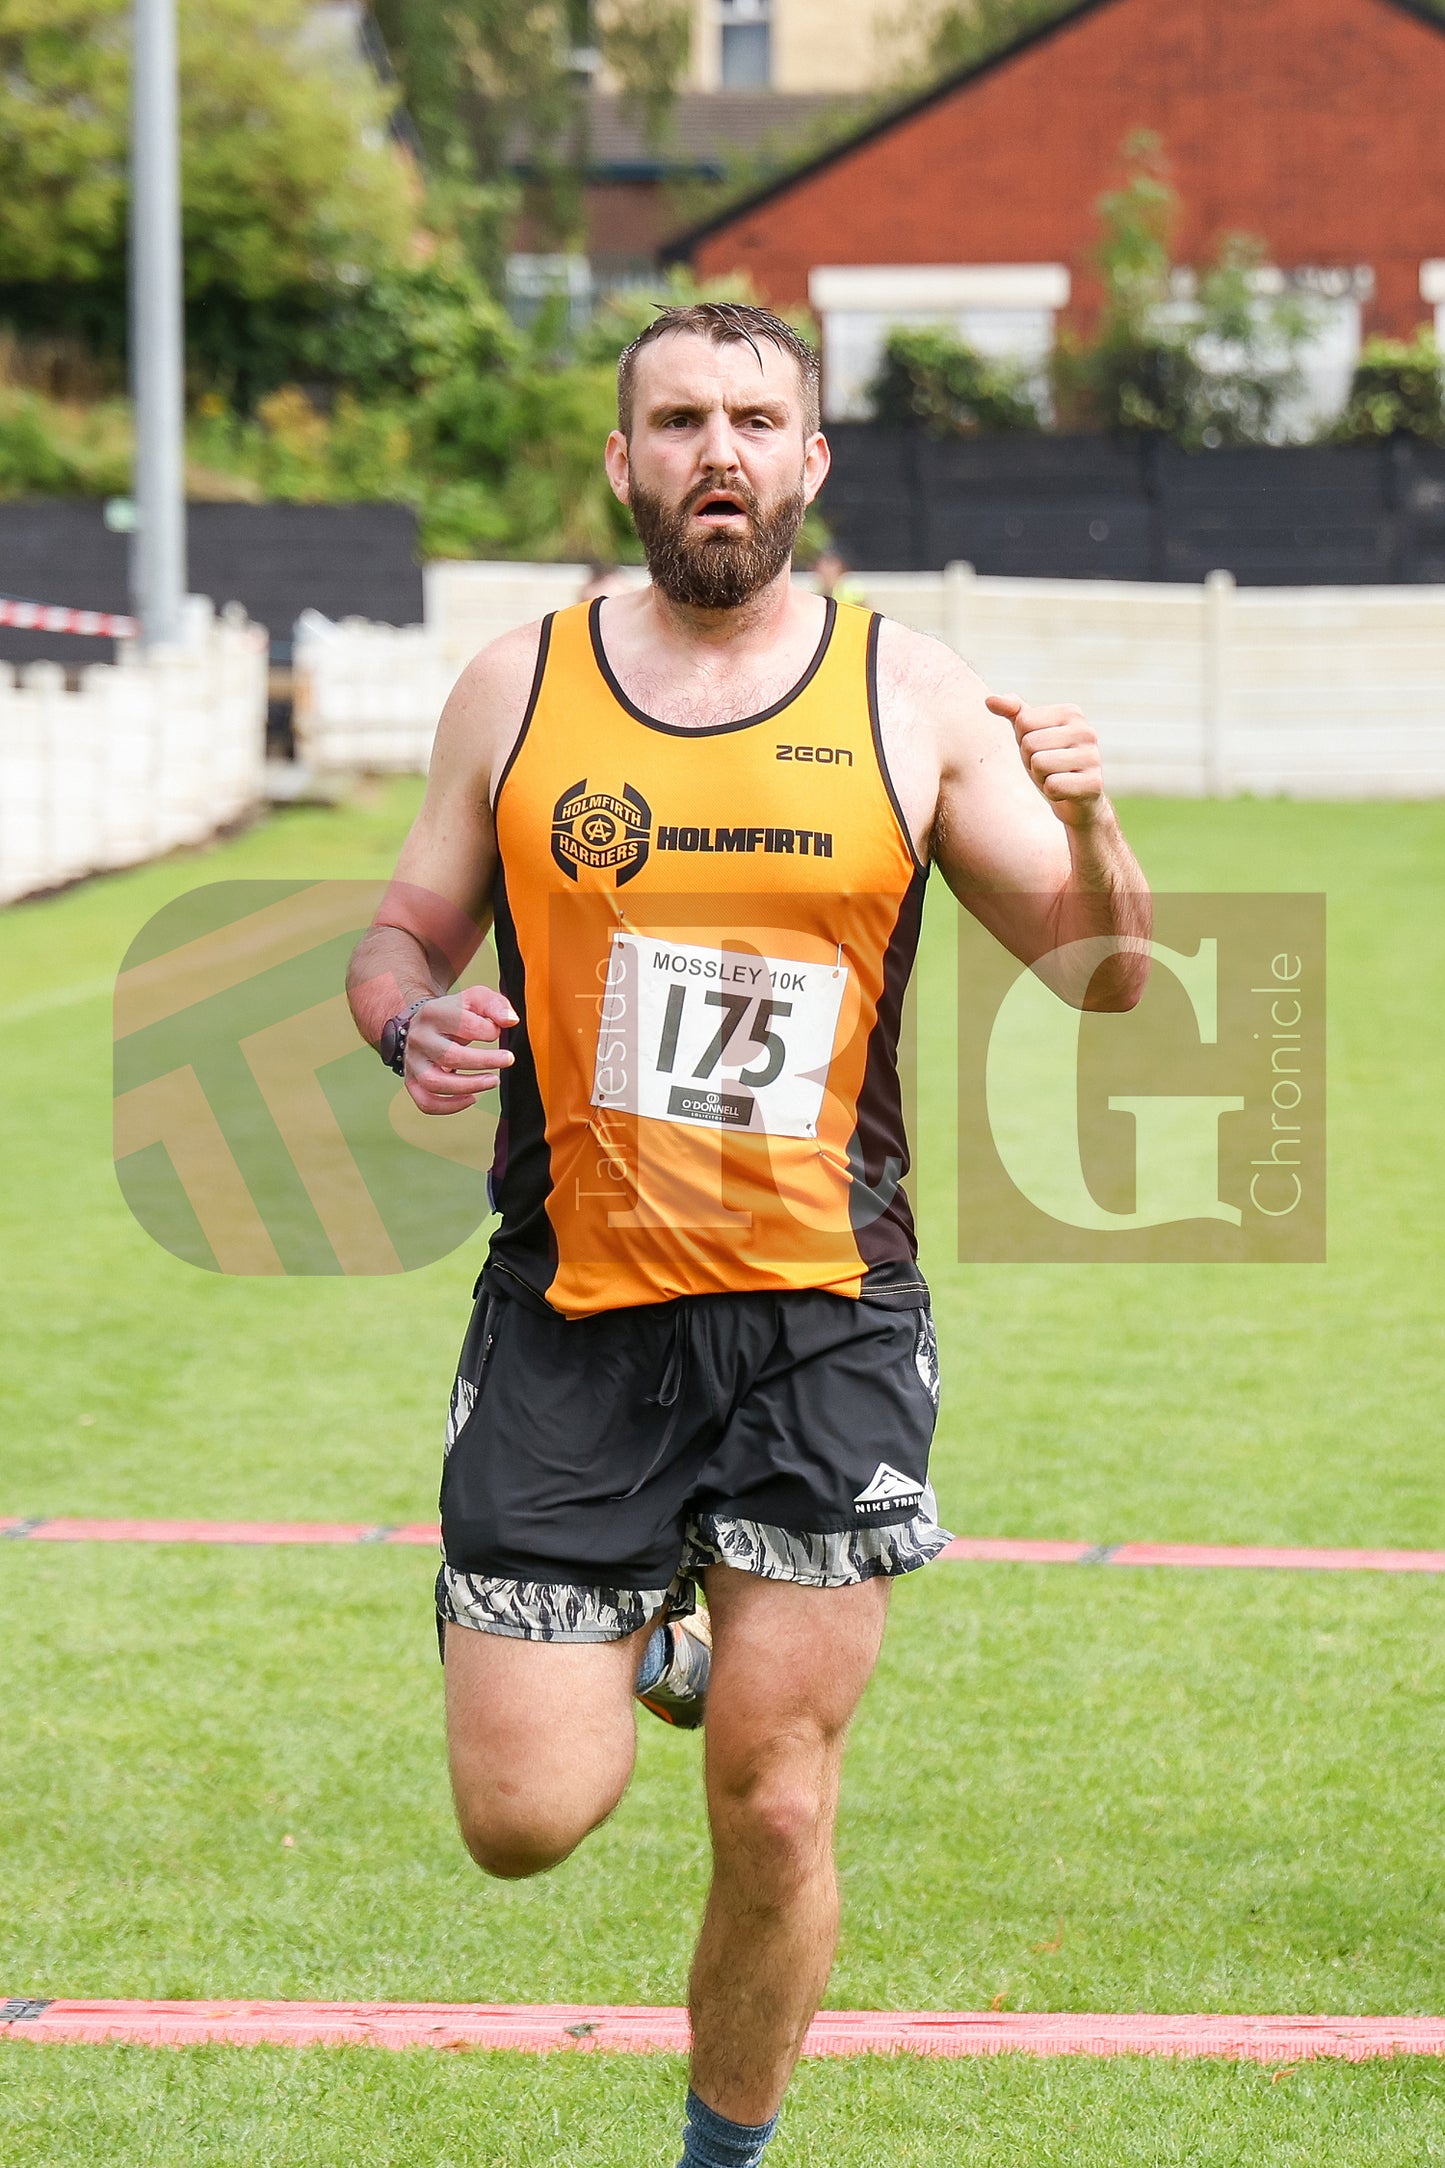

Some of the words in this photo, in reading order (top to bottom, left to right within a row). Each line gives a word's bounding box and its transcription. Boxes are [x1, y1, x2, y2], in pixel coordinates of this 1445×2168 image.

[776, 745, 853, 767] ZEON
[562, 796, 641, 826] HOLMFIRTH
[559, 835, 639, 866] HARRIERS
[657, 826, 833, 858] HOLMFIRTH
[653, 952, 763, 985] MOSSLEY
[769, 971, 808, 992] 10K
[656, 984, 793, 1088] 175
[682, 1099, 739, 1116] O'DONNELL
[855, 1501, 891, 1513] NIKE
